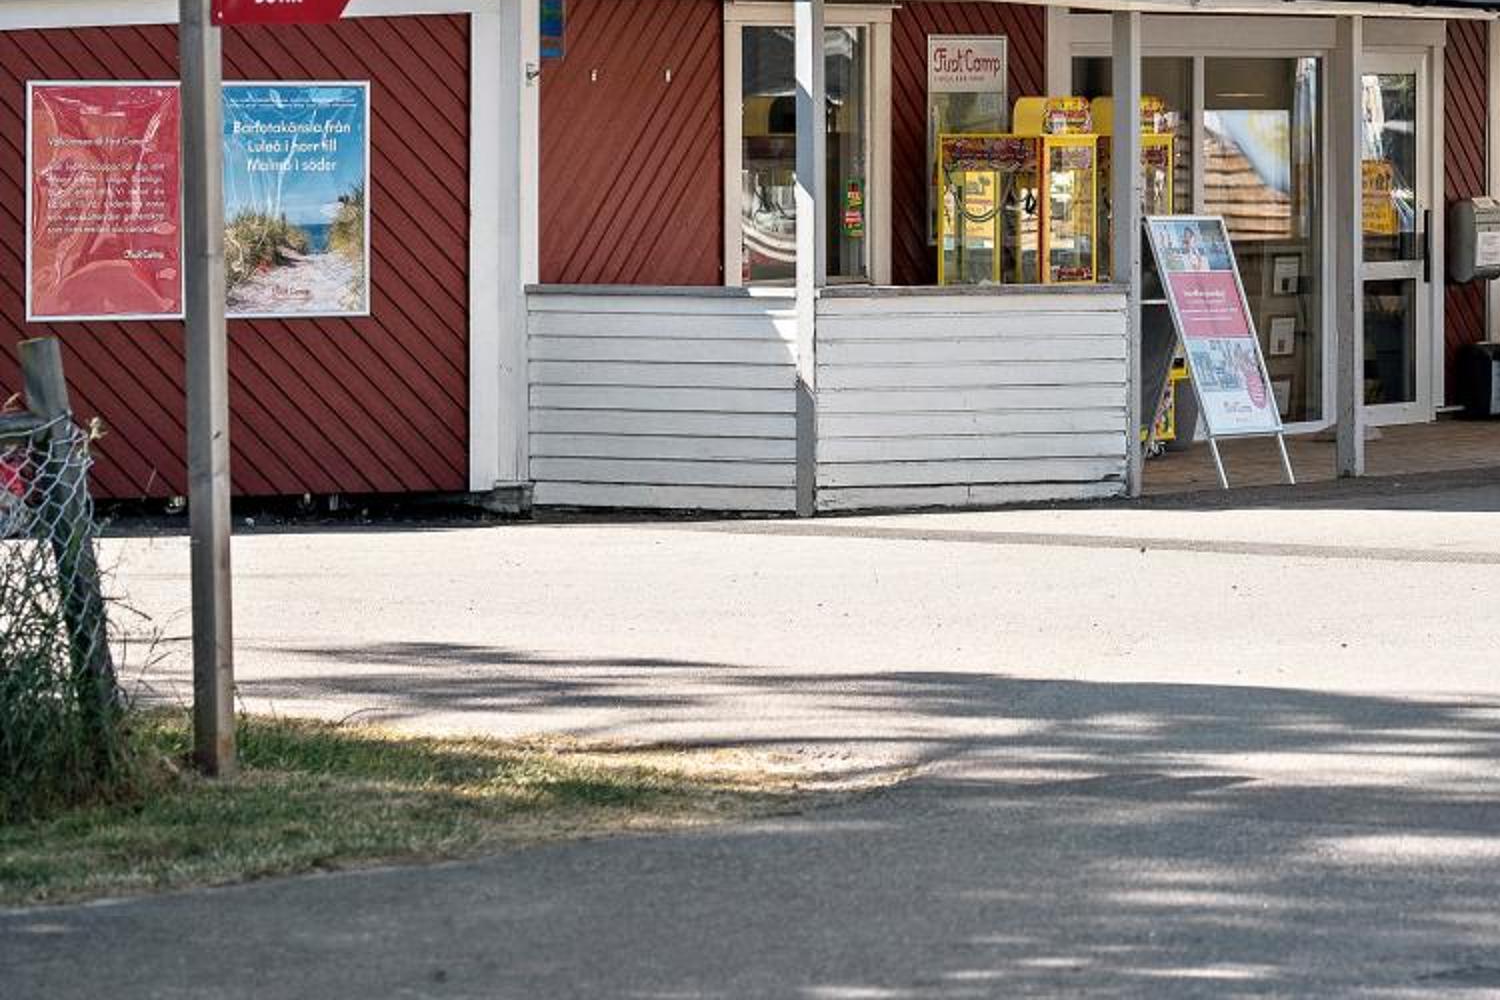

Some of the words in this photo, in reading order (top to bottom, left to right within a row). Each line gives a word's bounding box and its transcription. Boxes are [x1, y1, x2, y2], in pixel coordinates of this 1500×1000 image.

[965, 47, 1001, 78] Camp
[325, 119, 352, 135] från
[302, 156, 337, 171] söder
